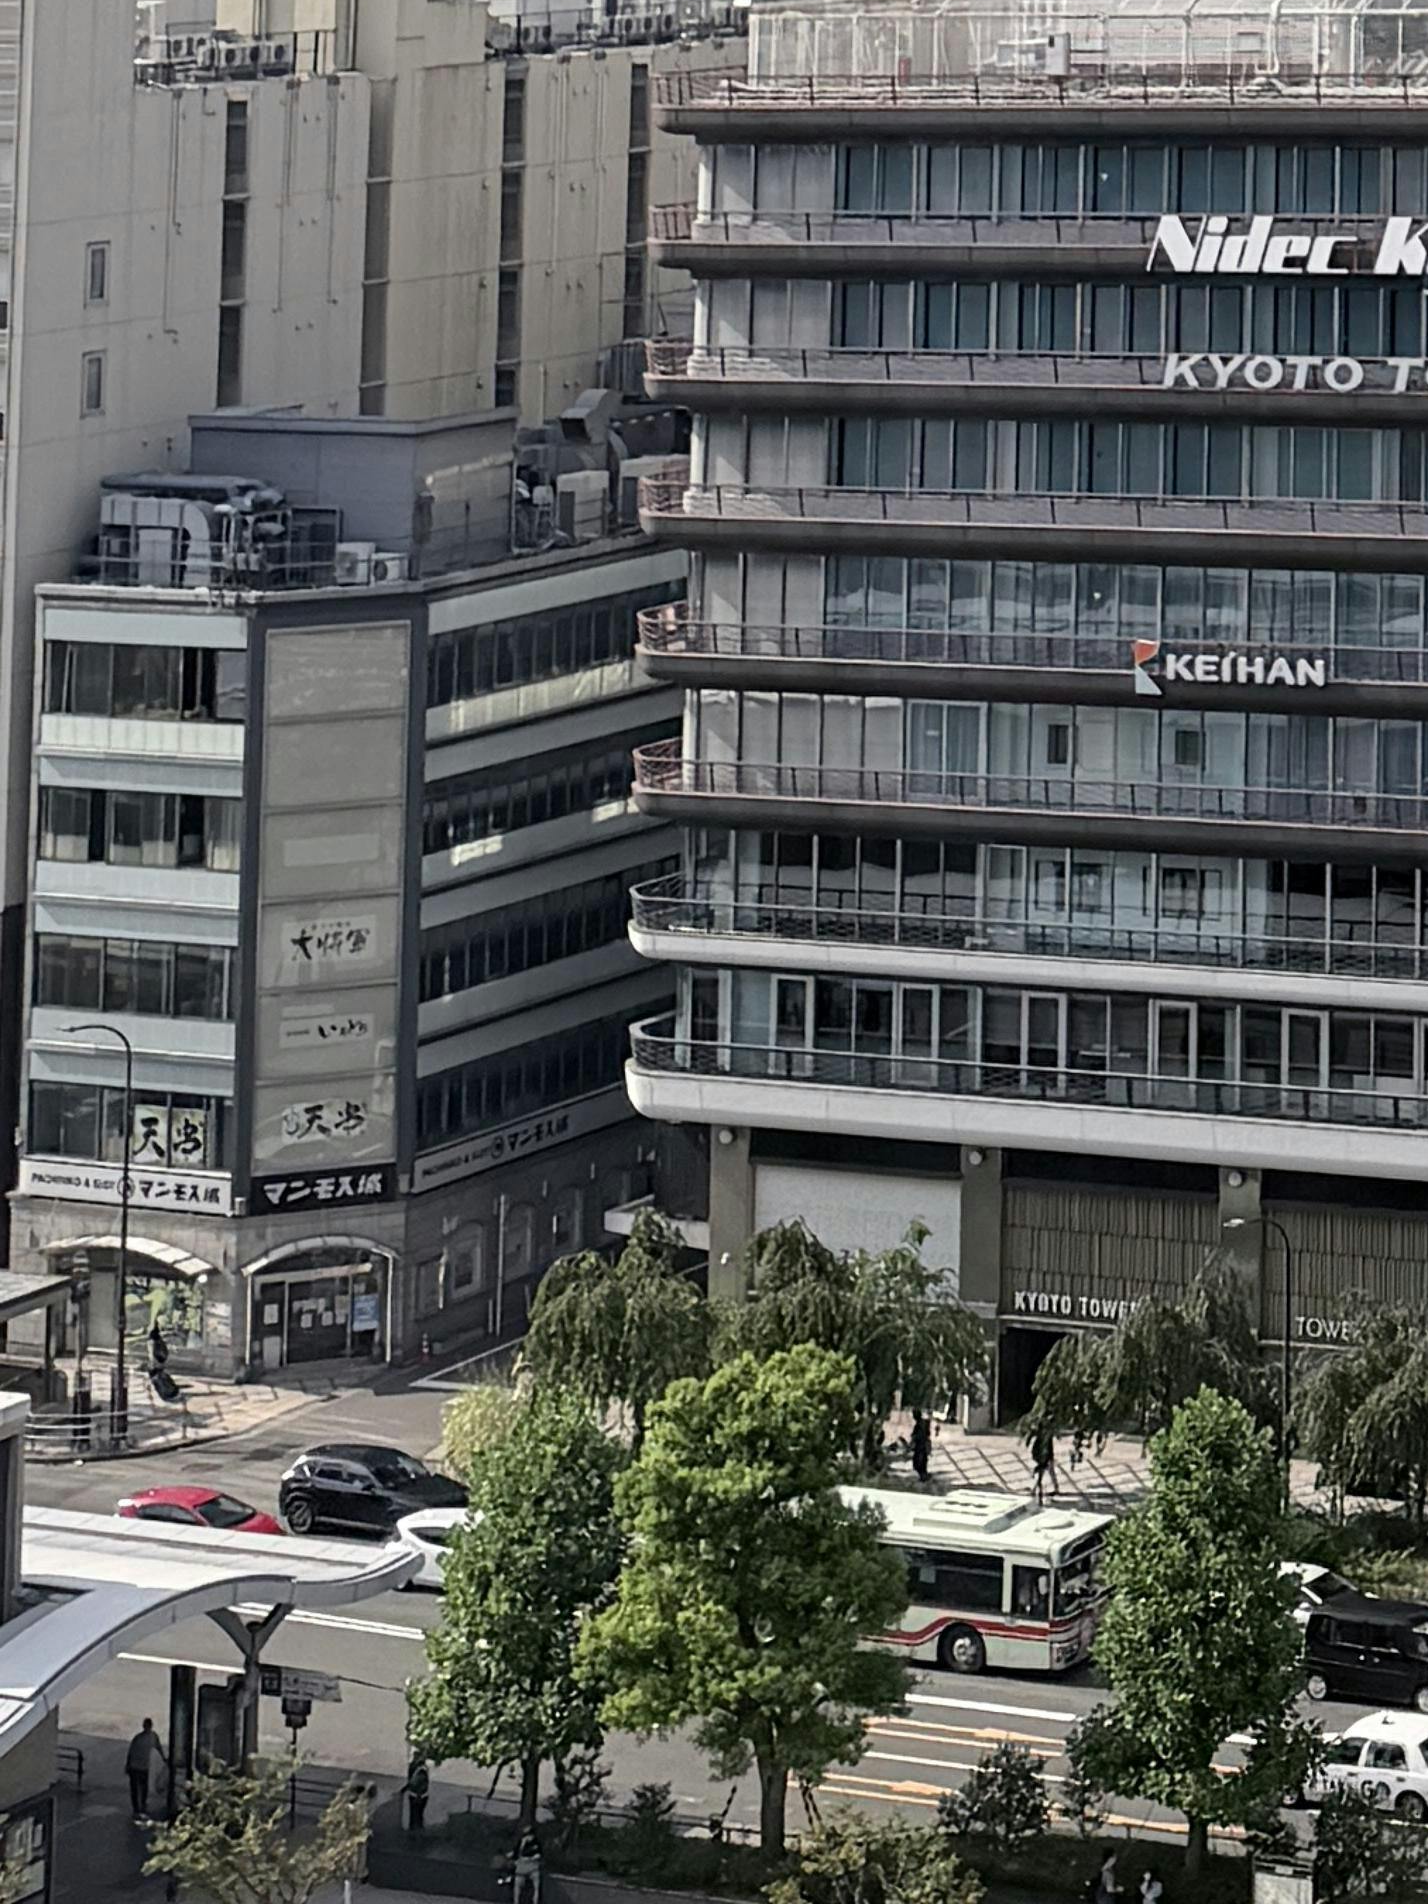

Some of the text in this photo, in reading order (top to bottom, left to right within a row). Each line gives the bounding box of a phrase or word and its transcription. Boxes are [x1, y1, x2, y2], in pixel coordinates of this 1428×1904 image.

[1146, 214, 1358, 274] Nidec
[1162, 354, 1364, 393] KYOTO
[1165, 651, 1326, 687] KEIHAN
[1015, 1291, 1137, 1320] KYOTO TOWE
[1295, 1316, 1362, 1343] TOWE
